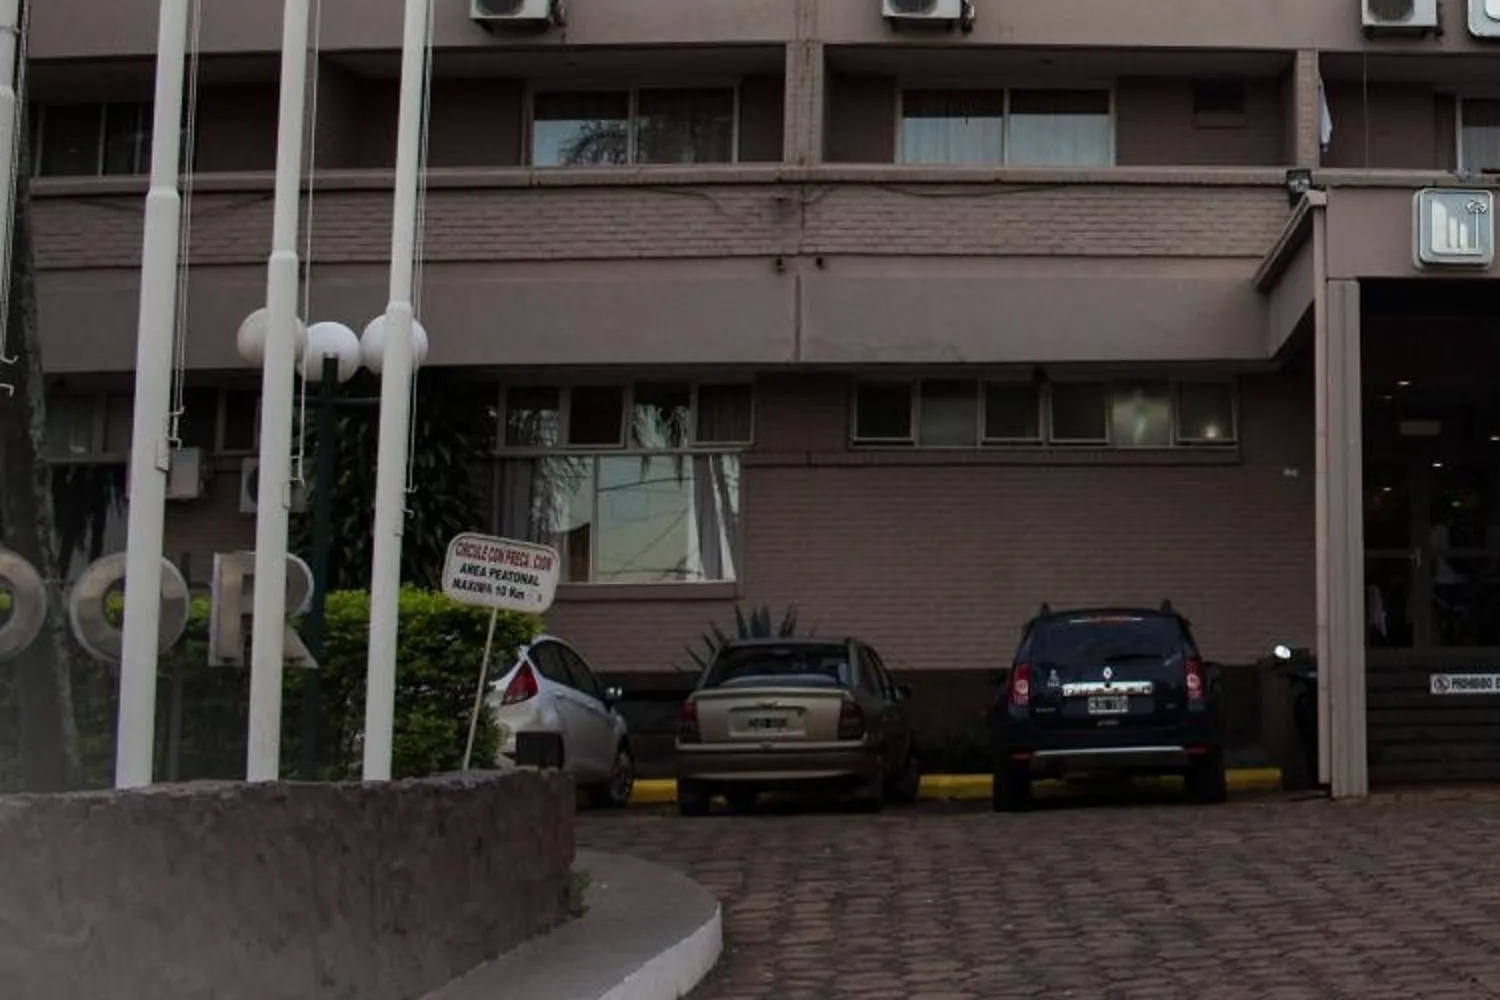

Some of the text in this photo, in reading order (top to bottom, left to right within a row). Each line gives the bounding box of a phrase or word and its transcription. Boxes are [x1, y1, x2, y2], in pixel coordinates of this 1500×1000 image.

[459, 563, 540, 587] AREA PEATONAL
[0, 545, 320, 668] OR
[1452, 677, 1492, 689] PROHIBIDO
